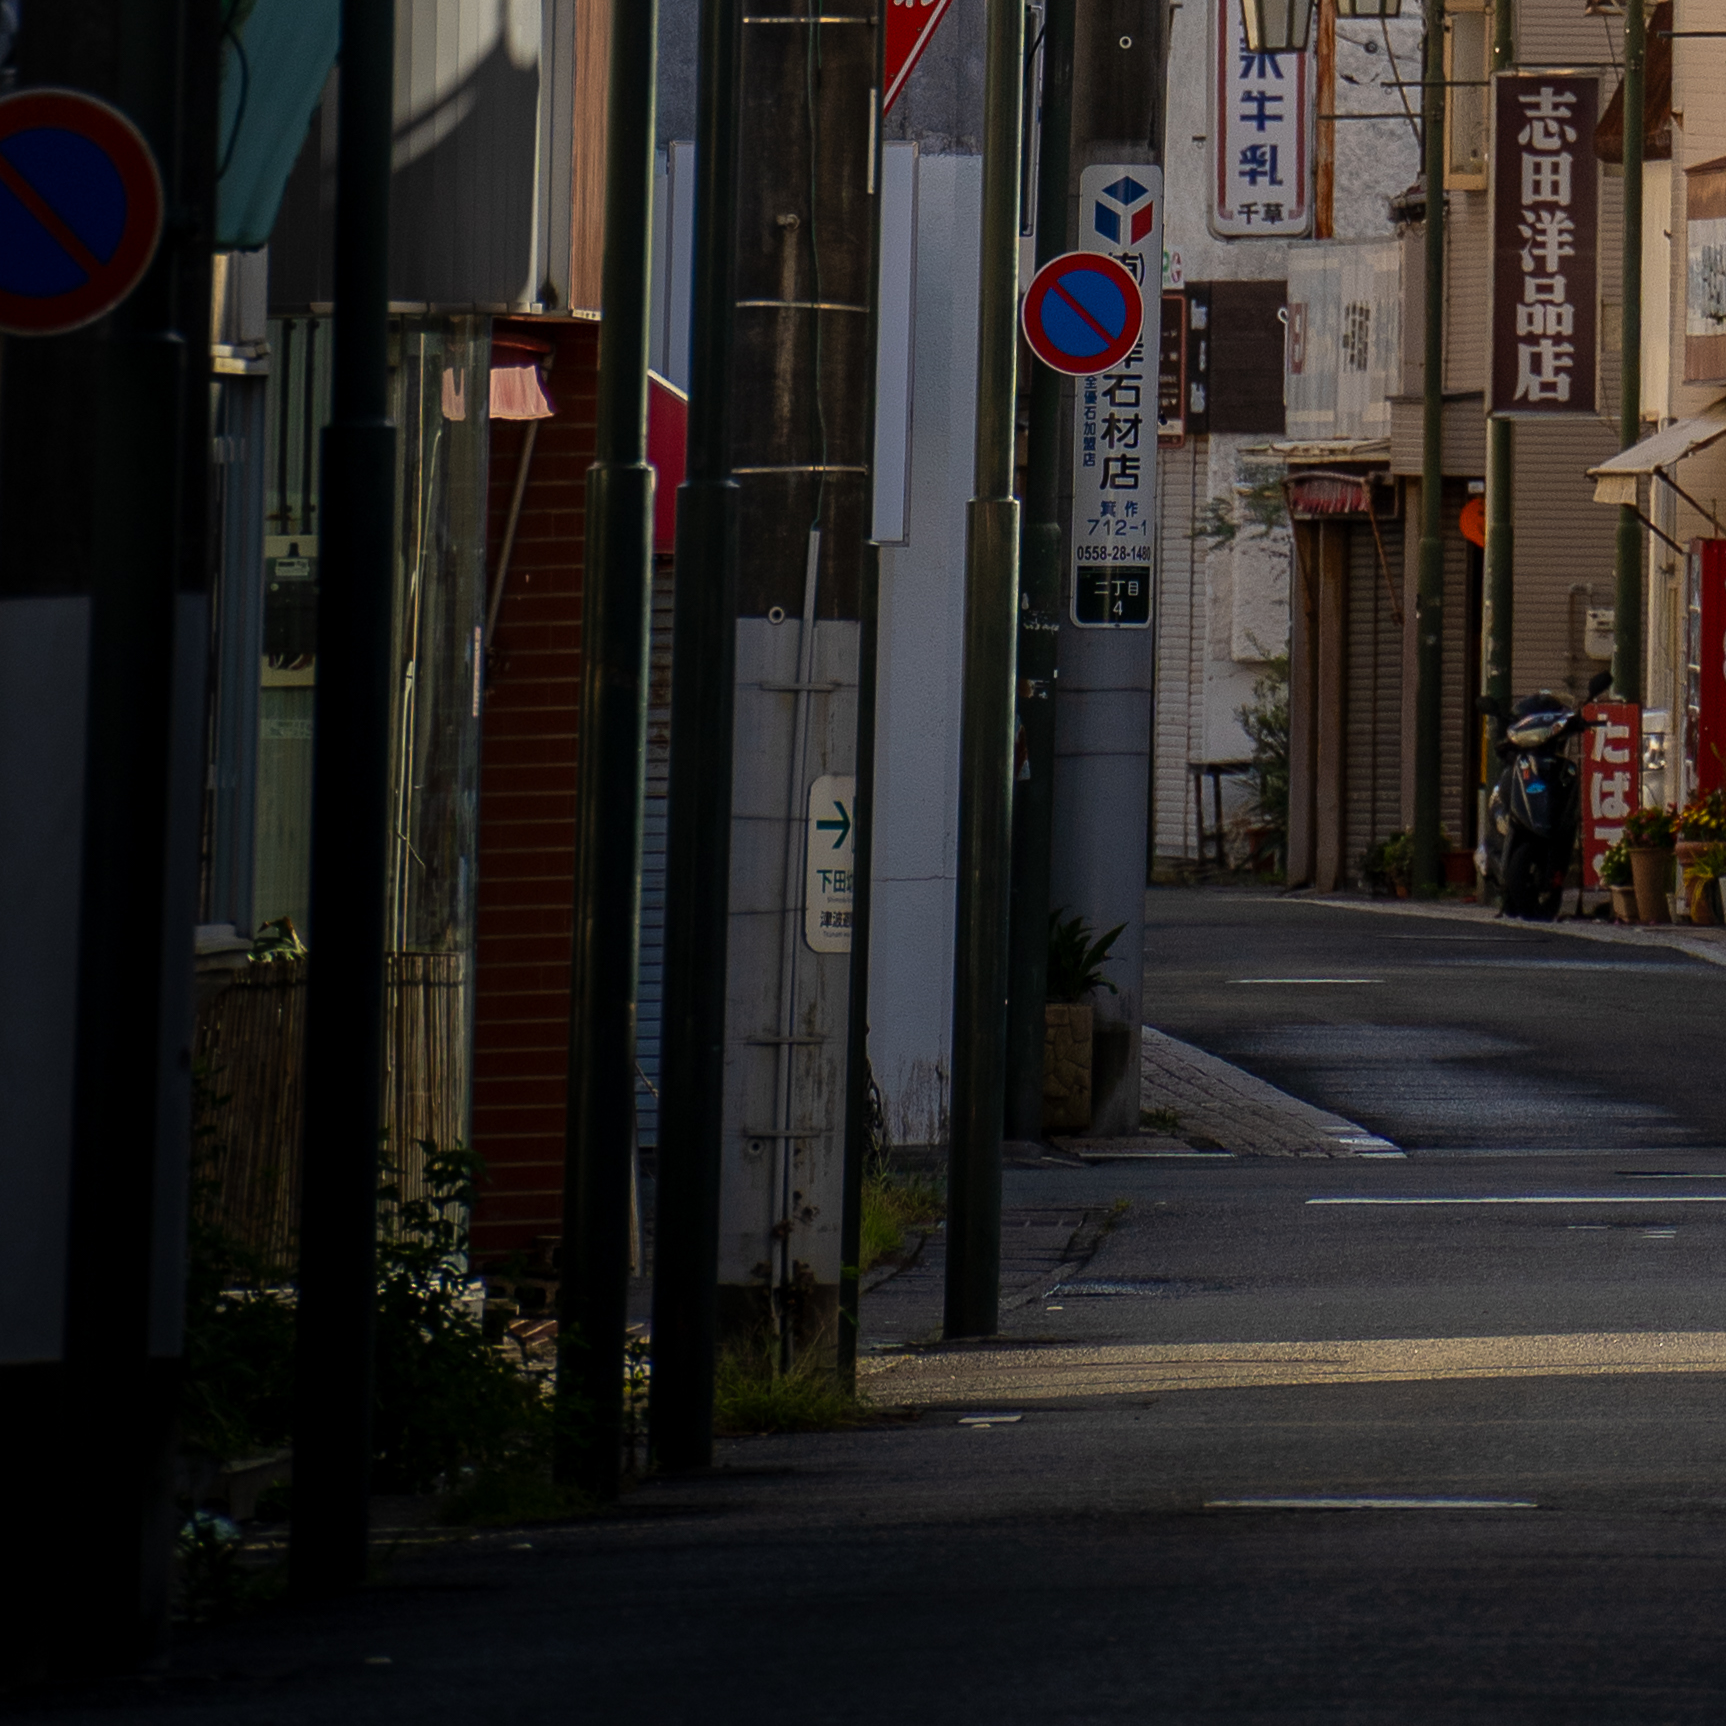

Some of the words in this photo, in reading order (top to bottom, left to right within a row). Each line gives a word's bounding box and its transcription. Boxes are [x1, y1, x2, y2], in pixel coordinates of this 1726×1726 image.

[1237, 202, 1284, 225] 千草
[1512, 86, 1578, 402] 志田洋品店
[1087, 519, 1147, 536] 712-1
[1093, 580, 1139, 597] 二丁目
[1112, 600, 1124, 617] 4
